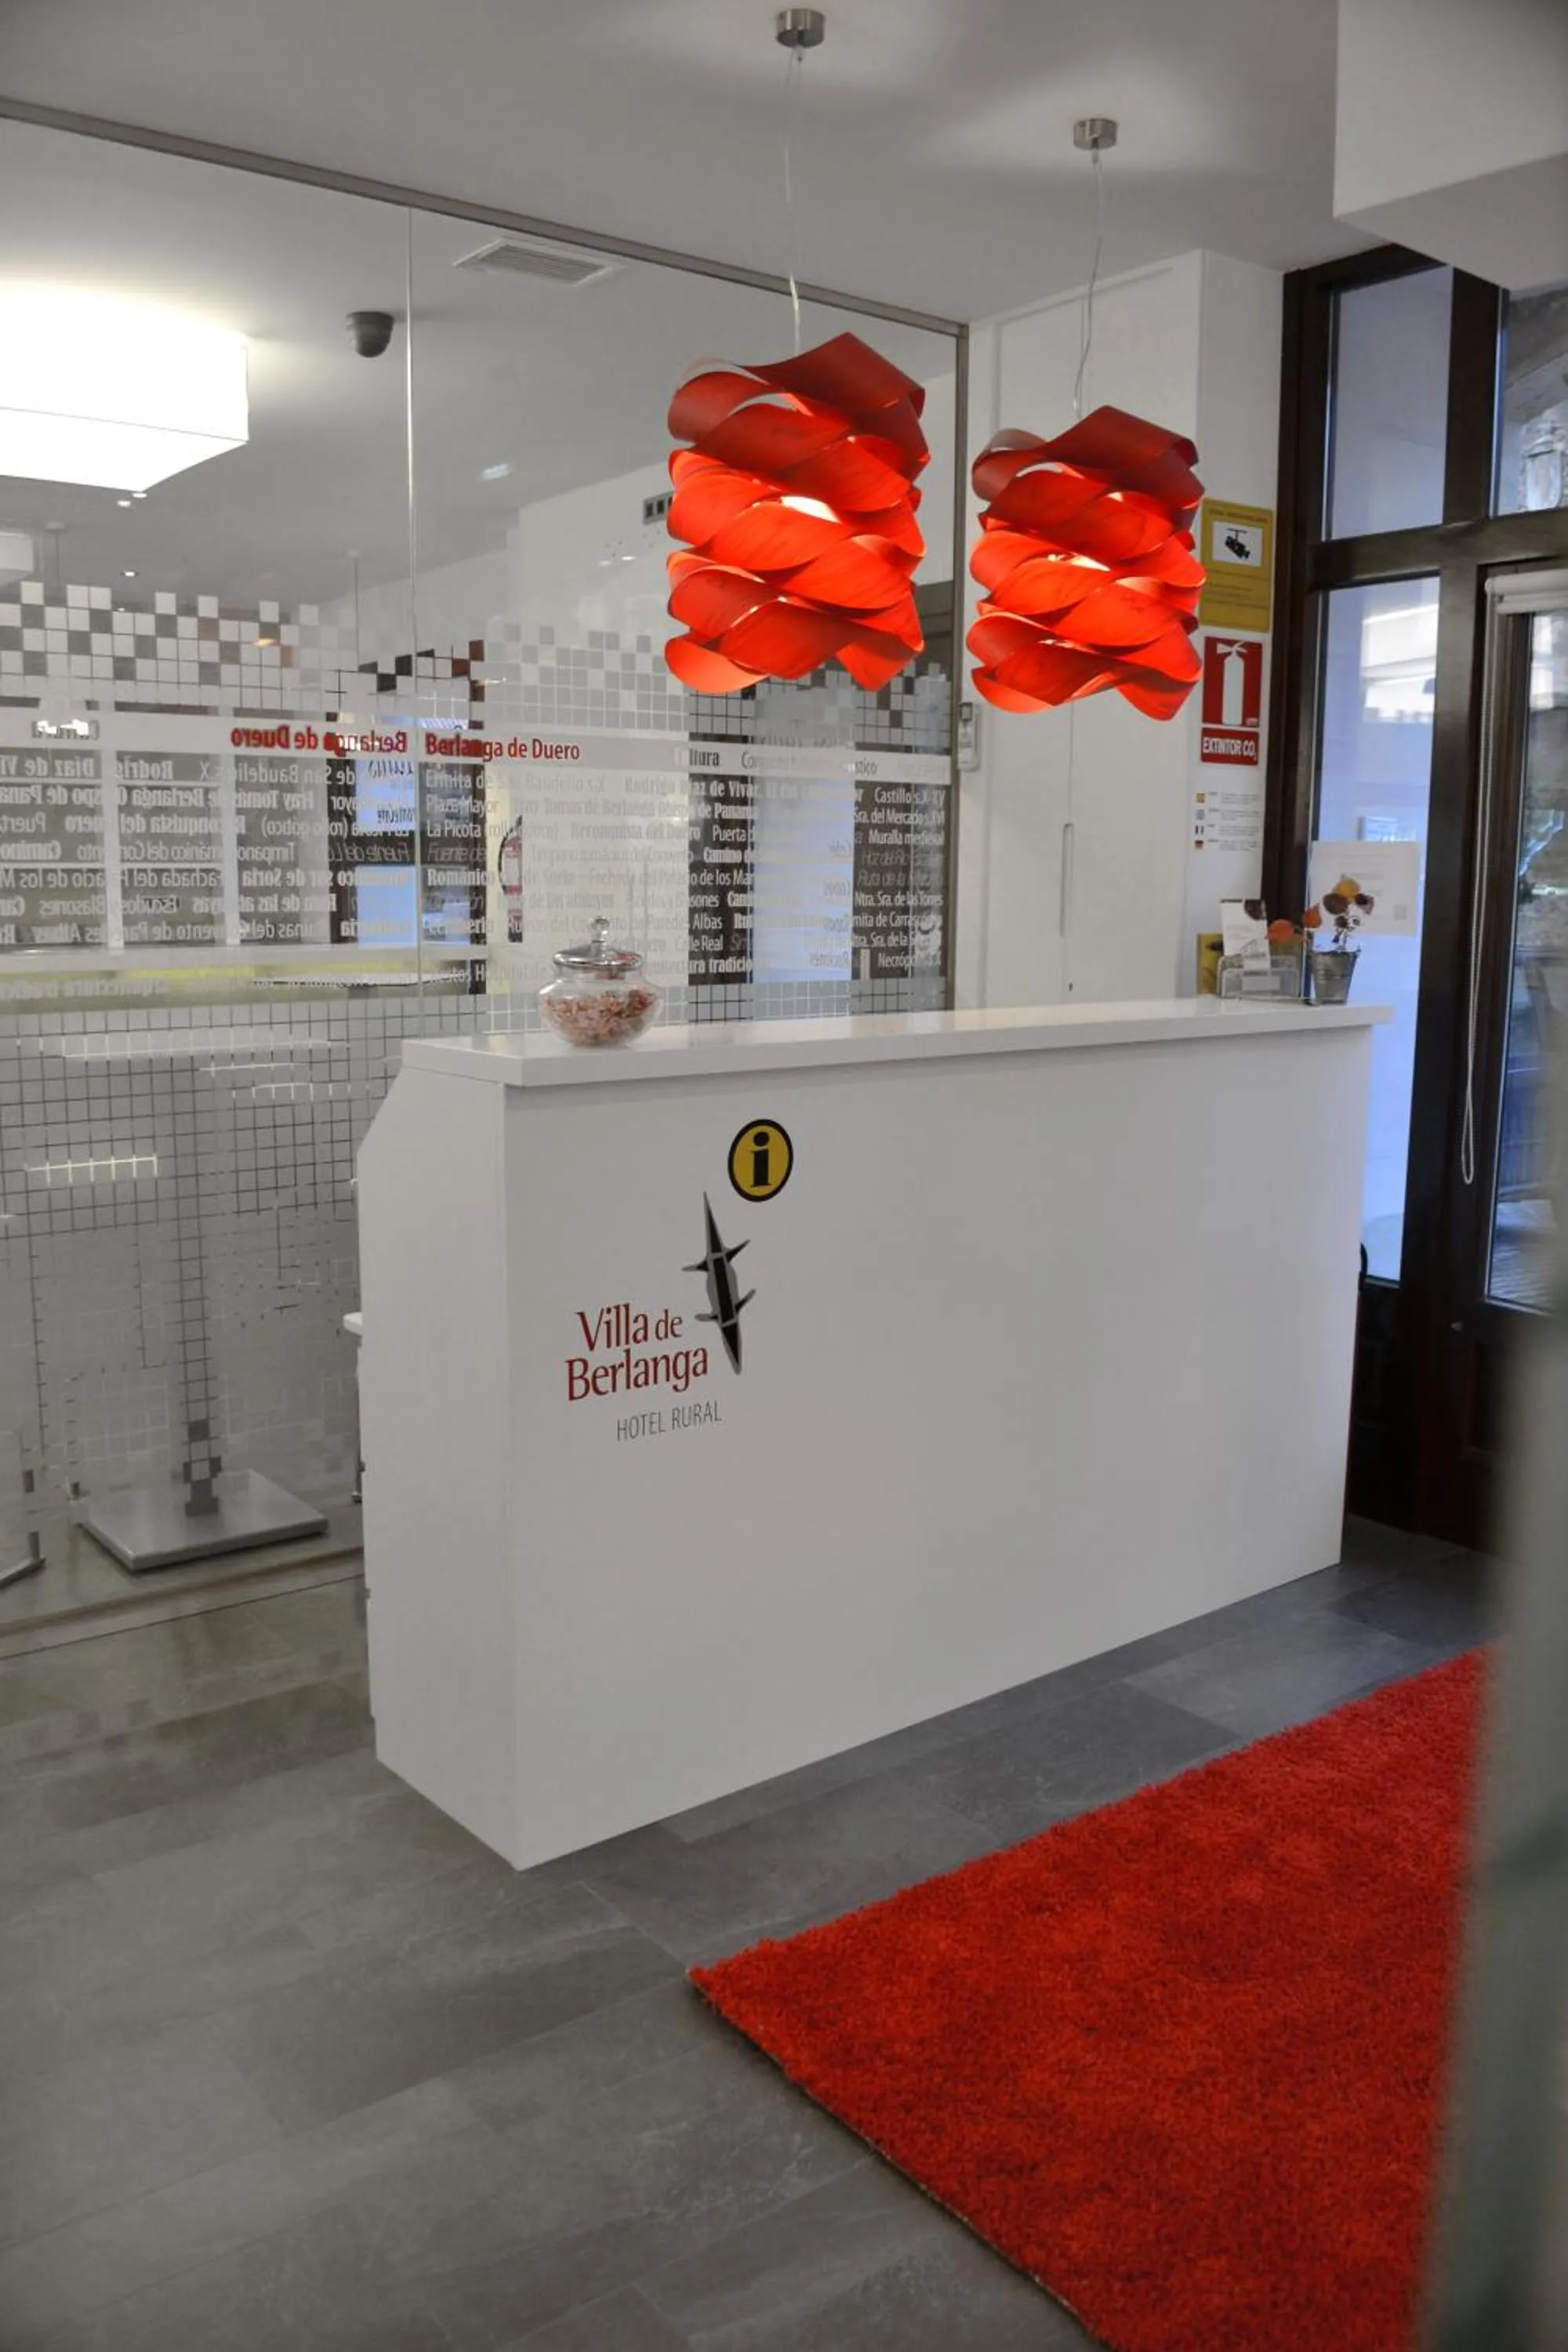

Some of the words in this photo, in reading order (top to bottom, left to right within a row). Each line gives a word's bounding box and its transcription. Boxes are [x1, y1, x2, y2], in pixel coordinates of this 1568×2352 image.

[425, 732, 503, 763] Berlanga
[508, 738, 528, 759] de
[532, 738, 580, 760] Duero
[575, 1302, 649, 1352] Villa
[655, 1308, 684, 1341] de
[565, 1346, 709, 1401] Berlanga
[616, 1412, 666, 1442] HOTEL
[671, 1399, 722, 1430] RURAL
